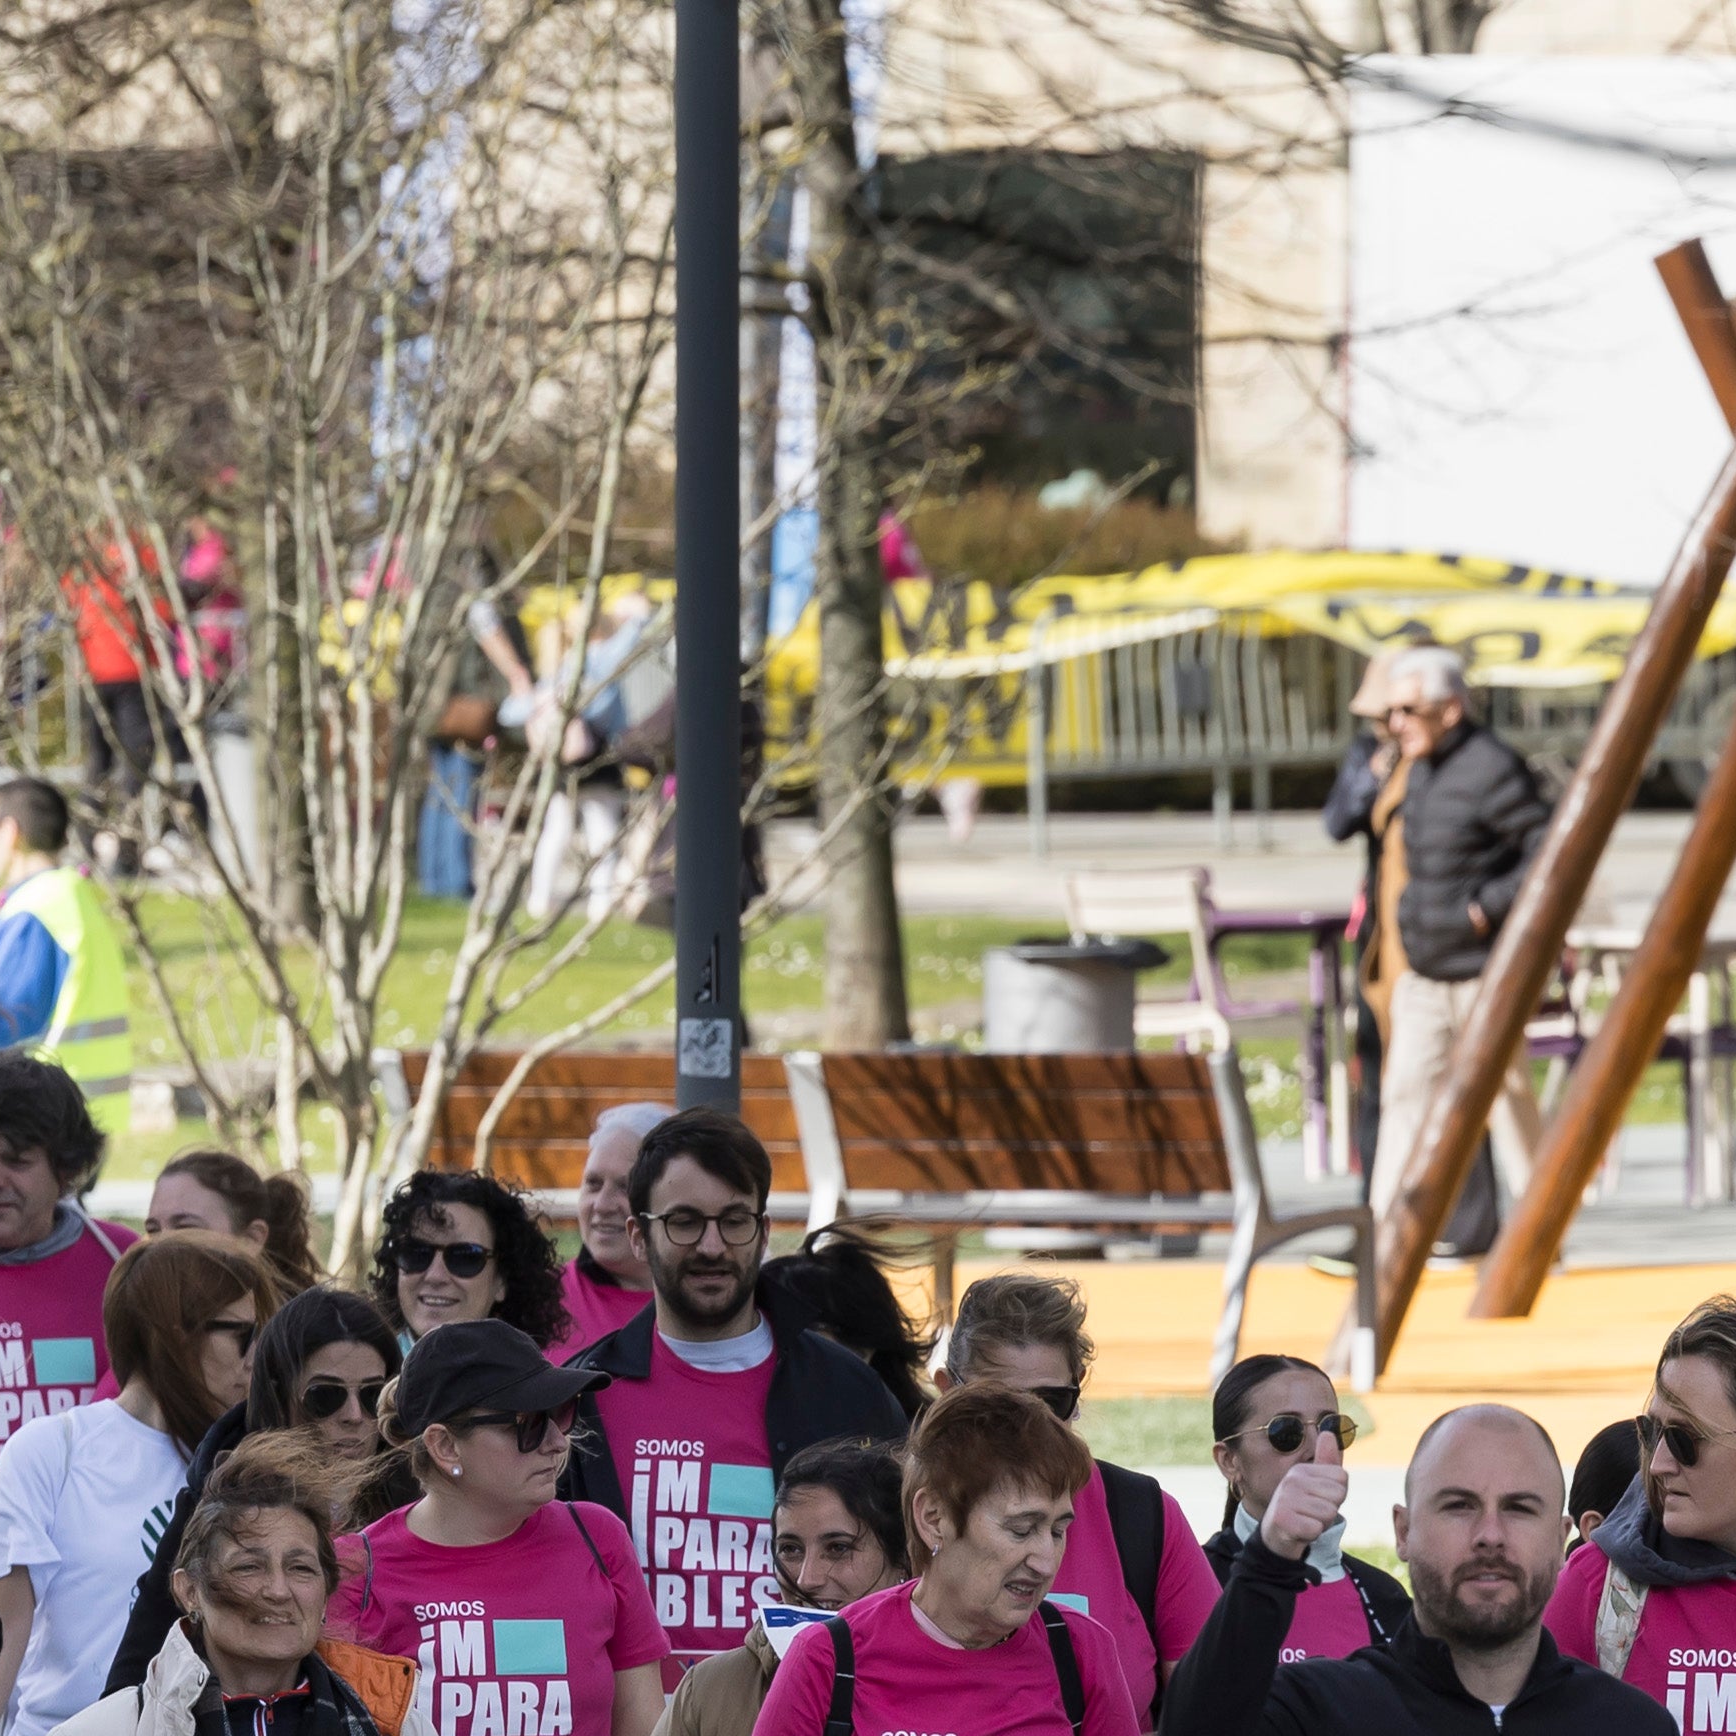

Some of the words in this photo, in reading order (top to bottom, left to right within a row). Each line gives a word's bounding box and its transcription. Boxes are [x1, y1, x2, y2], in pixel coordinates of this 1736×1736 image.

[635, 1439, 705, 1457] SOMOS
[655, 1517, 774, 1573] PARA
[414, 1601, 485, 1622] SOMOS
